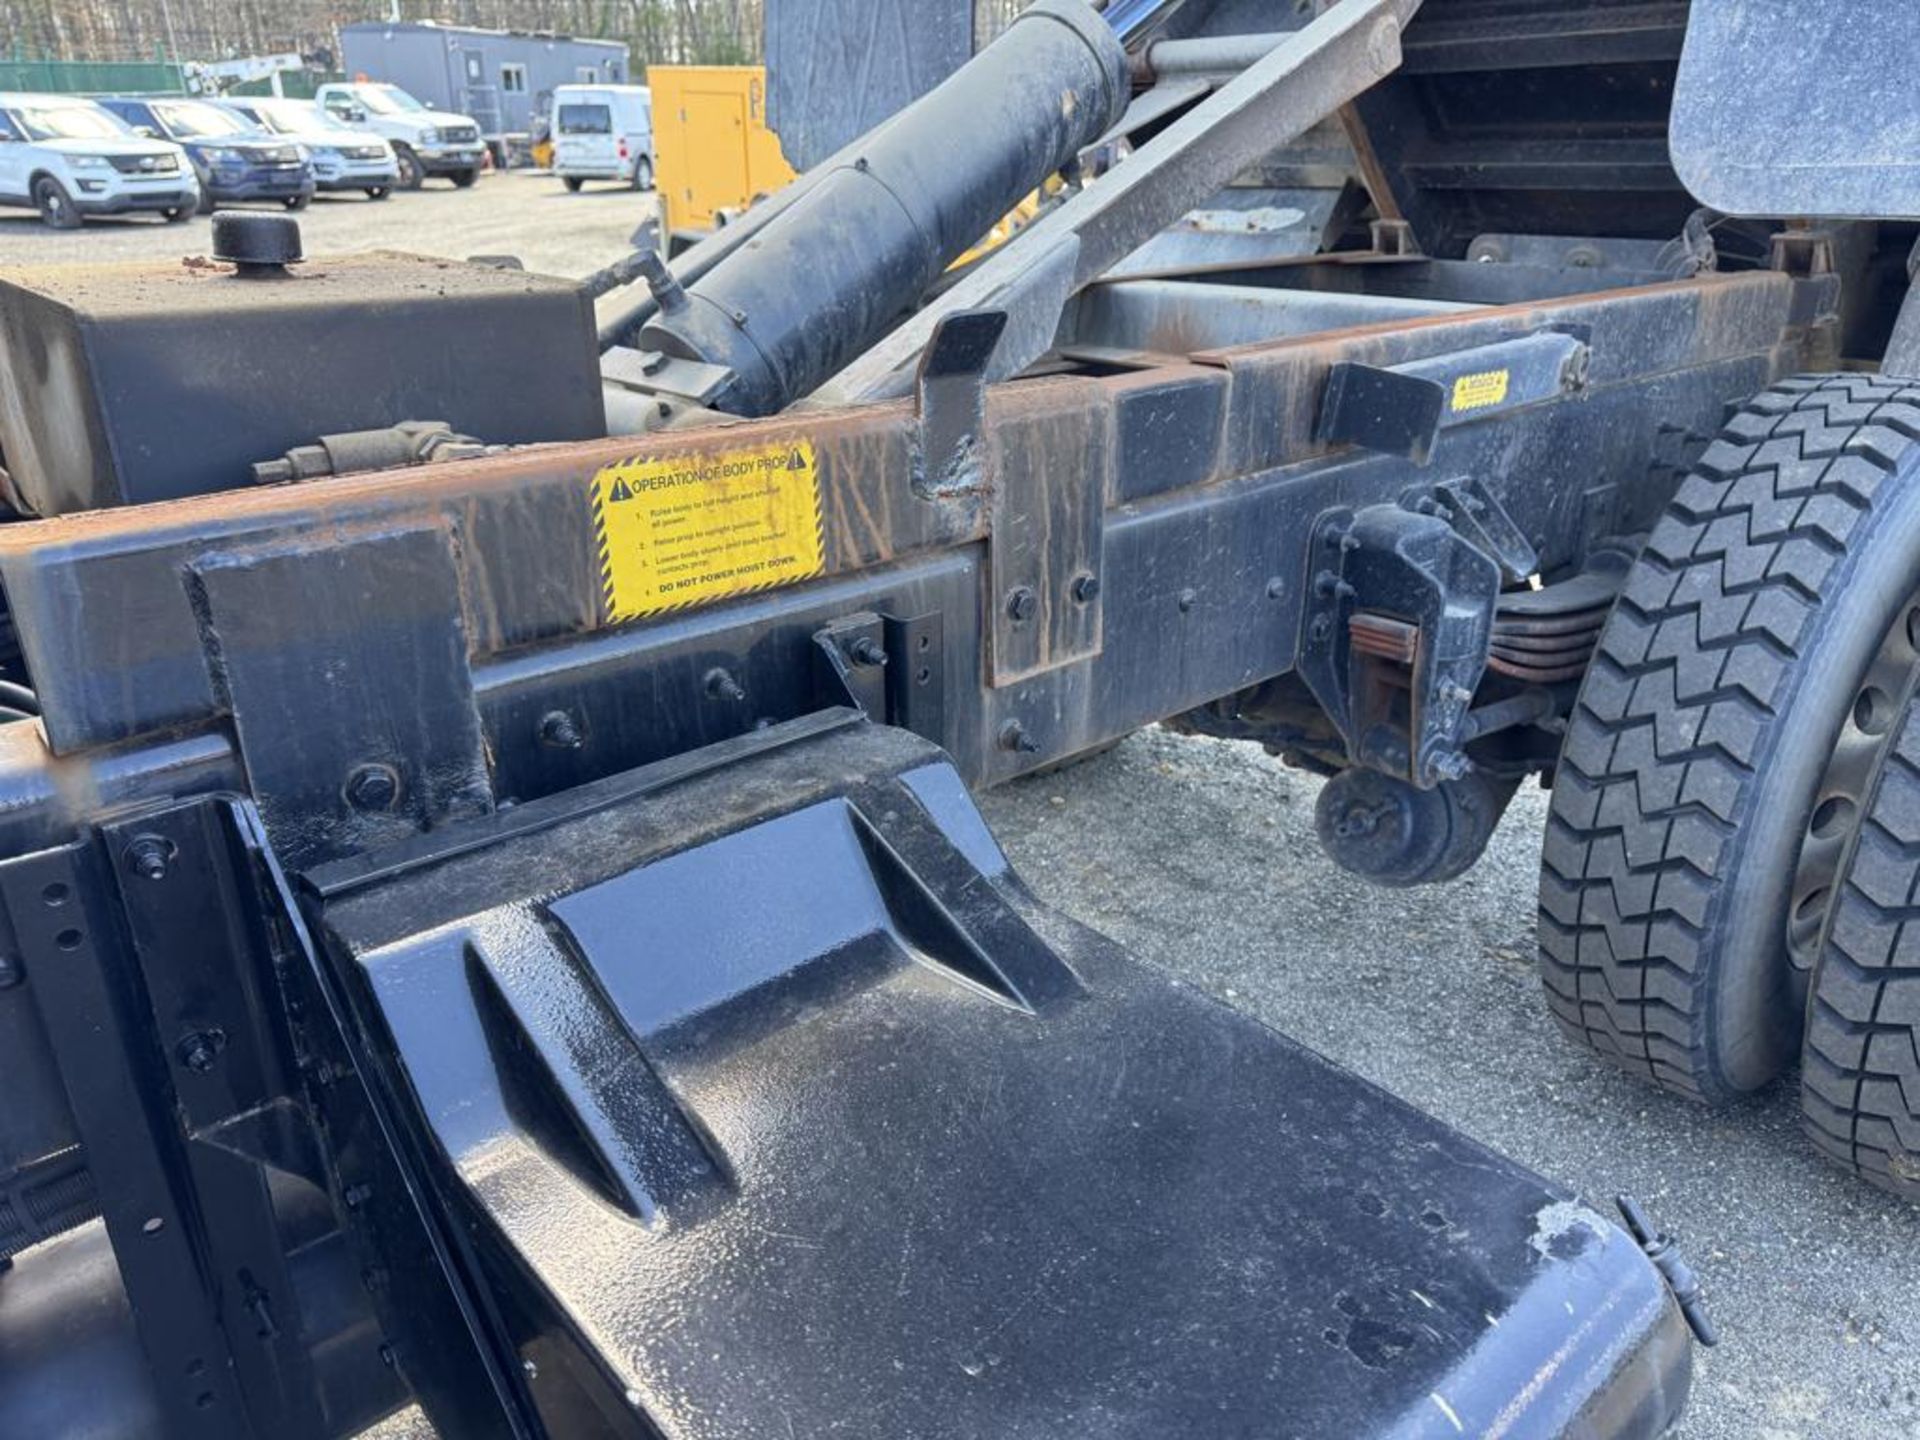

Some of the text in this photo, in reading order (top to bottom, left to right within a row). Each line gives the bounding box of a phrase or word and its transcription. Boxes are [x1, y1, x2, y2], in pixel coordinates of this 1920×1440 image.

[631, 455, 787, 494] OPERATION OF BODY PROP
[680, 549, 699, 560] body
[659, 583, 674, 593] DO
[676, 576, 698, 589] NOT
[700, 568, 735, 583] POWER
[736, 561, 766, 576] HOIST
